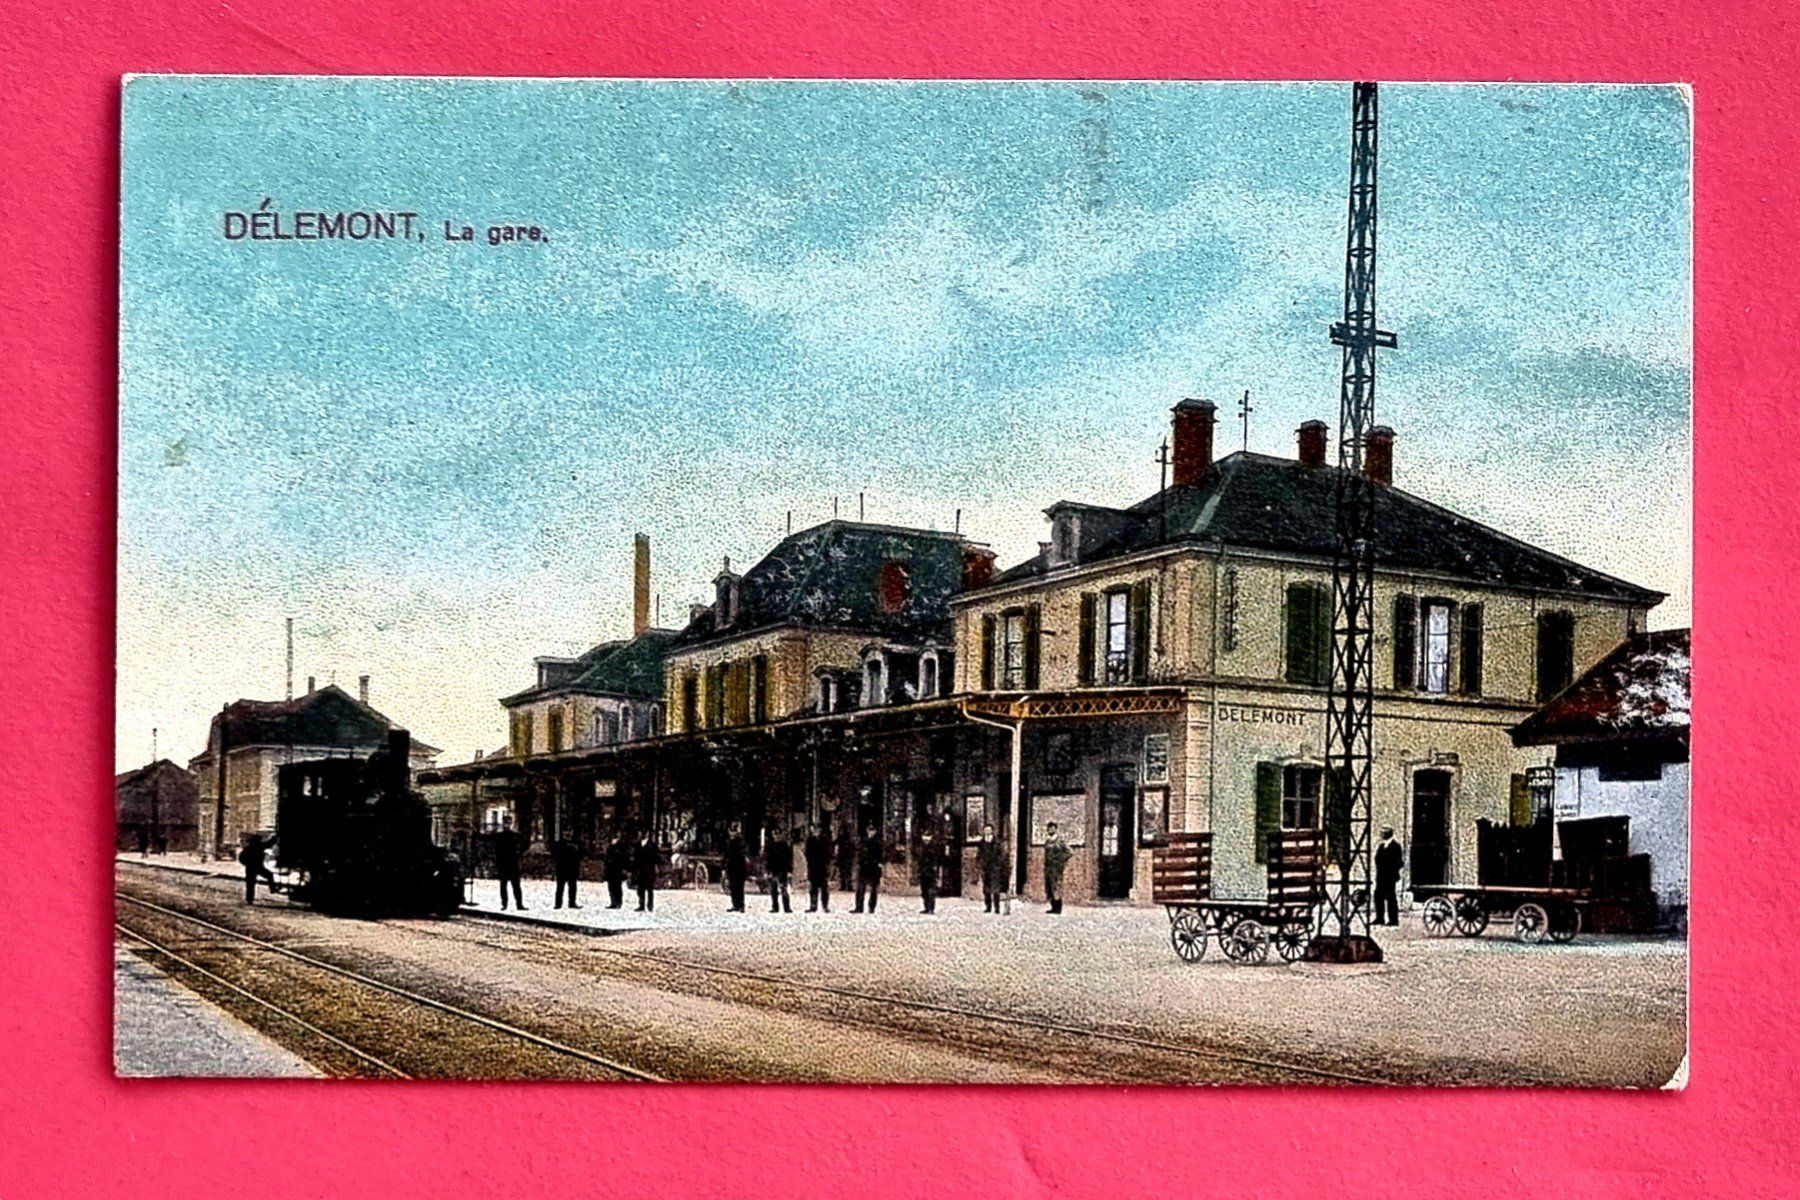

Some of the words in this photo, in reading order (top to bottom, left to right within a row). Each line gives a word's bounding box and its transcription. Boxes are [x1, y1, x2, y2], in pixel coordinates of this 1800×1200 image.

[223, 197, 425, 242] DÉLEMONT,
[444, 220, 474, 242] La
[488, 224, 549, 246] gare.
[1218, 707, 1306, 725] DELEMONT
